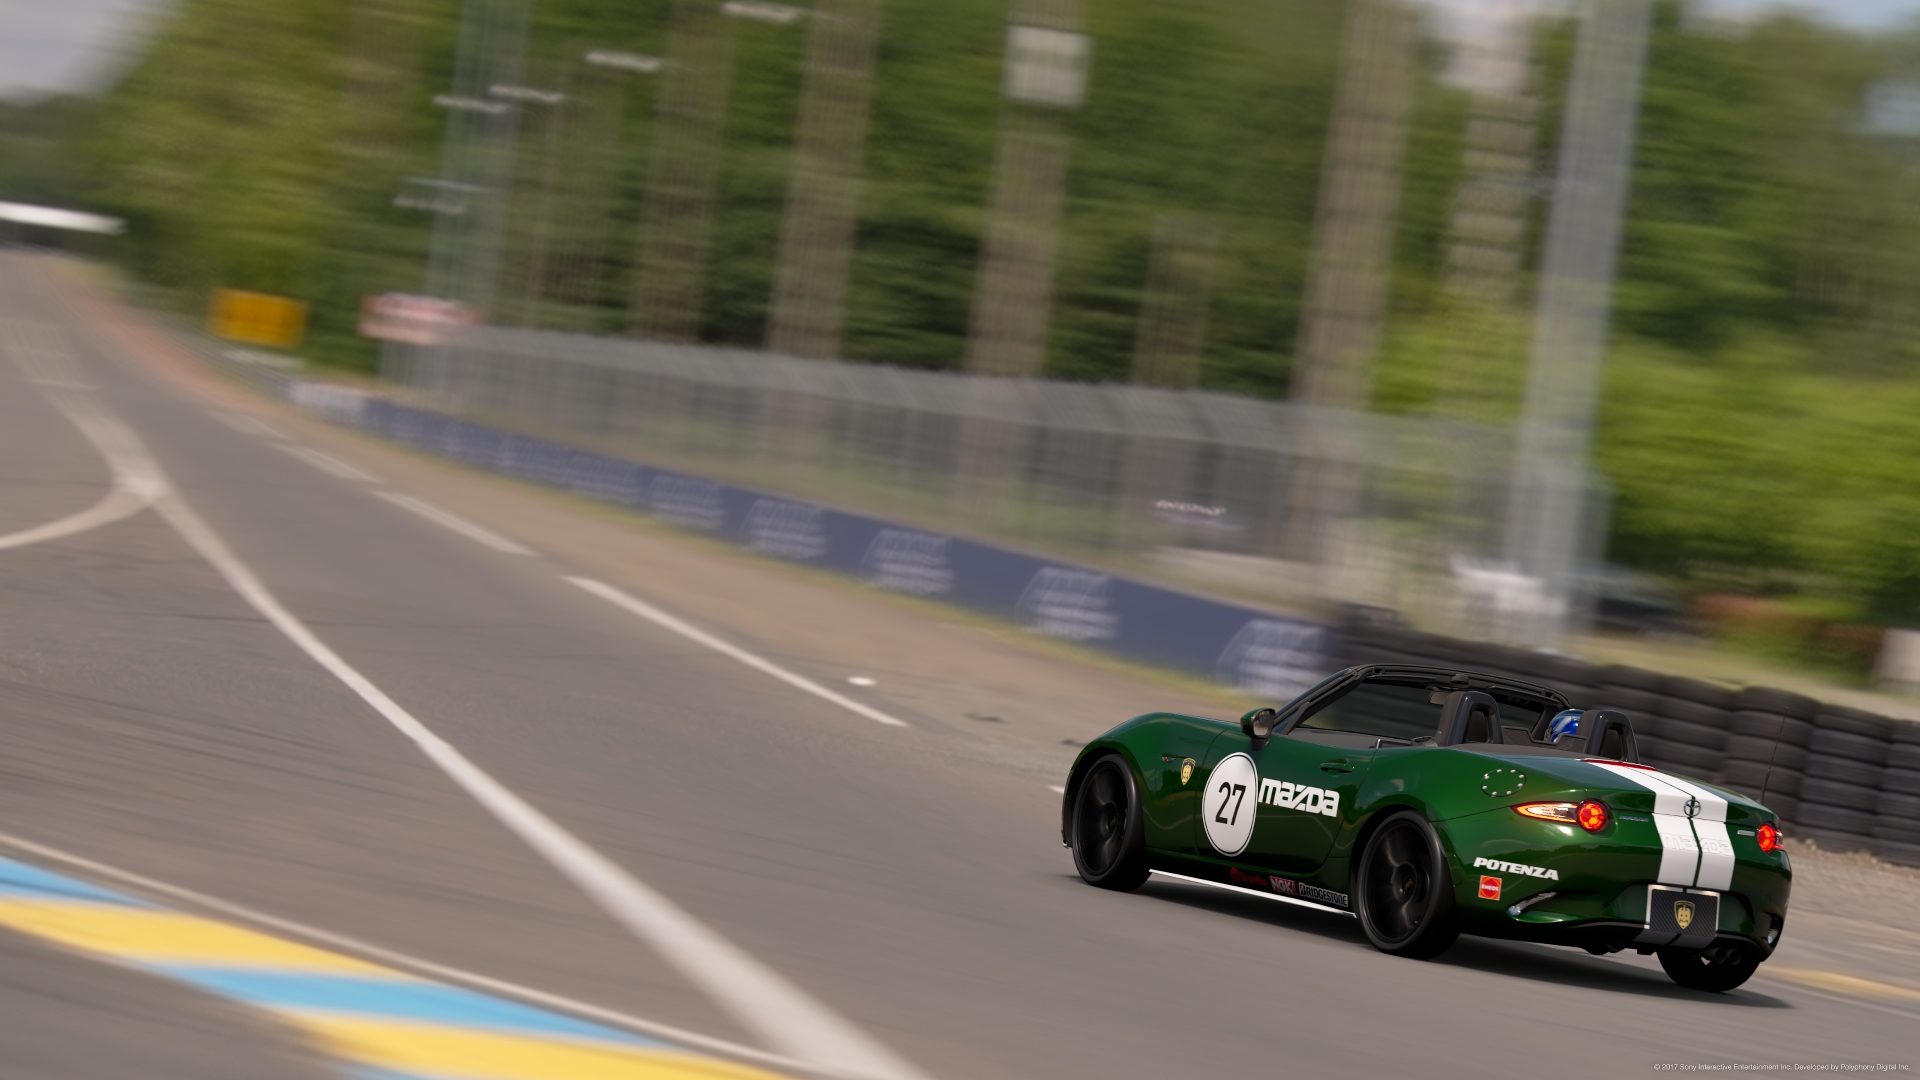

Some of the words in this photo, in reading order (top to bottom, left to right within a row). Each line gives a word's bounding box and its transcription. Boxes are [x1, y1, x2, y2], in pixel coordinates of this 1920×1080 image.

[1215, 782, 1247, 826] 27
[1258, 778, 1340, 817] mazda
[1473, 857, 1559, 880] POTENZA
[1301, 884, 1347, 906] BRIDGESTONE
